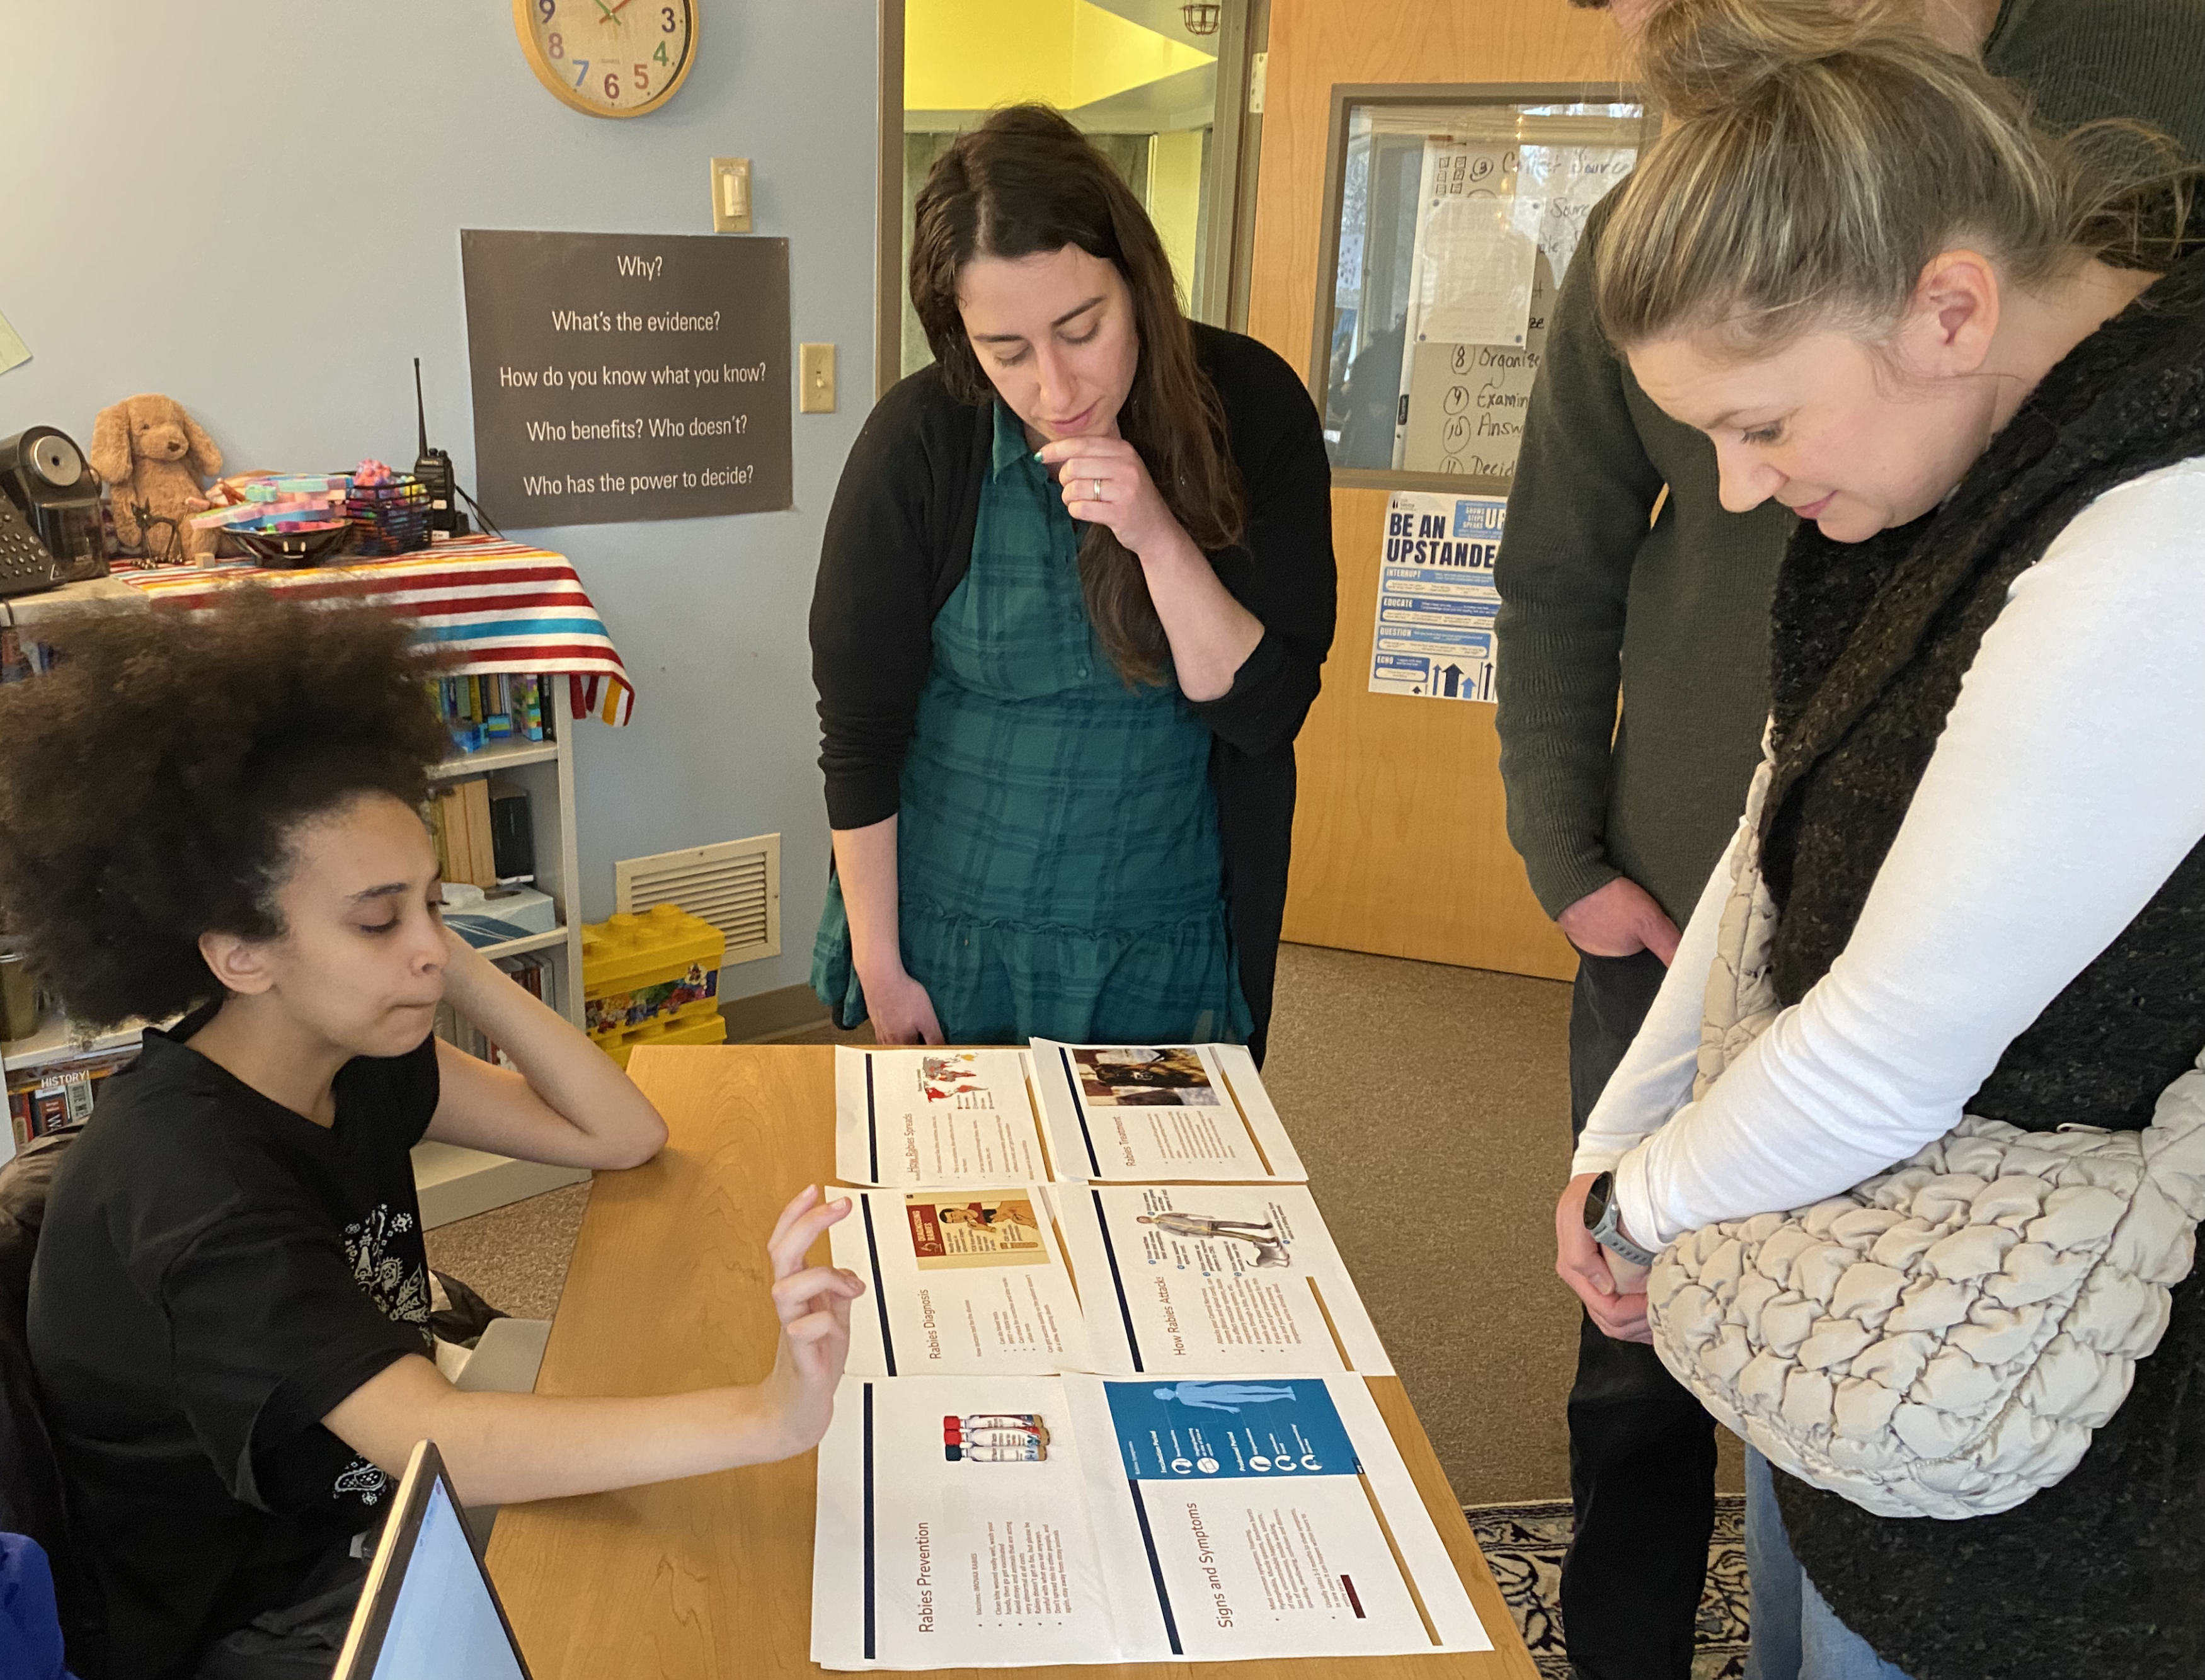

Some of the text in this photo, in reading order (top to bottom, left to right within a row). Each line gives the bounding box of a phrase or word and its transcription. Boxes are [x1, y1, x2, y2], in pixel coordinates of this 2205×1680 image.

[539, 0, 555, 24] 9
[662, 7, 675, 33] 3
[549, 33, 564, 59] 8
[653, 40, 668, 66] 4
[573, 60, 589, 86] 7
[634, 64, 649, 89] 5
[604, 73, 619, 99] 6
[617, 256, 663, 280] Why?
[552, 311, 720, 331] What’s the evidence?
[500, 362, 765, 390] How do you know what you know?
[1477, 383, 1528, 409] Examin
[527, 416, 747, 441] Who benefits? Who doesn’t?
[1477, 412, 1524, 437] Answ
[1472, 455, 1515, 477] Decid
[524, 466, 753, 496] Who has the power to decide?
[1389, 513, 1414, 537] BE
[1419, 515, 1446, 539] AN
[1387, 539, 1496, 568] UPSTANDE
[1387, 569, 1421, 578] INTERRUPT
[1384, 598, 1412, 608] EDUCATE
[1380, 627, 1411, 637] QUESTION
[1377, 656, 1394, 664] ECHO
[42, 1070, 89, 1088] HISTORY!
[903, 1113, 915, 1135] Spreads
[905, 1137, 915, 1156] Rabies
[1113, 1116, 1136, 1165] Rabies Treatment
[912, 1210, 925, 1241] DIAGNOSING
[924, 1222, 935, 1240] RABIES
[917, 1289, 941, 1358] Rabies Diagnosis
[1152, 1277, 1186, 1355] How Rabies Attacks
[1149, 1431, 1167, 1472] Incubation Period
[1227, 1432, 1237, 1446] Period
[990, 1558, 998, 1570] really
[998, 1543, 1006, 1568] vaccinated
[1187, 1503, 1233, 1628] Signs and Symptoms
[915, 1522, 933, 1632] Rabies Prevention
